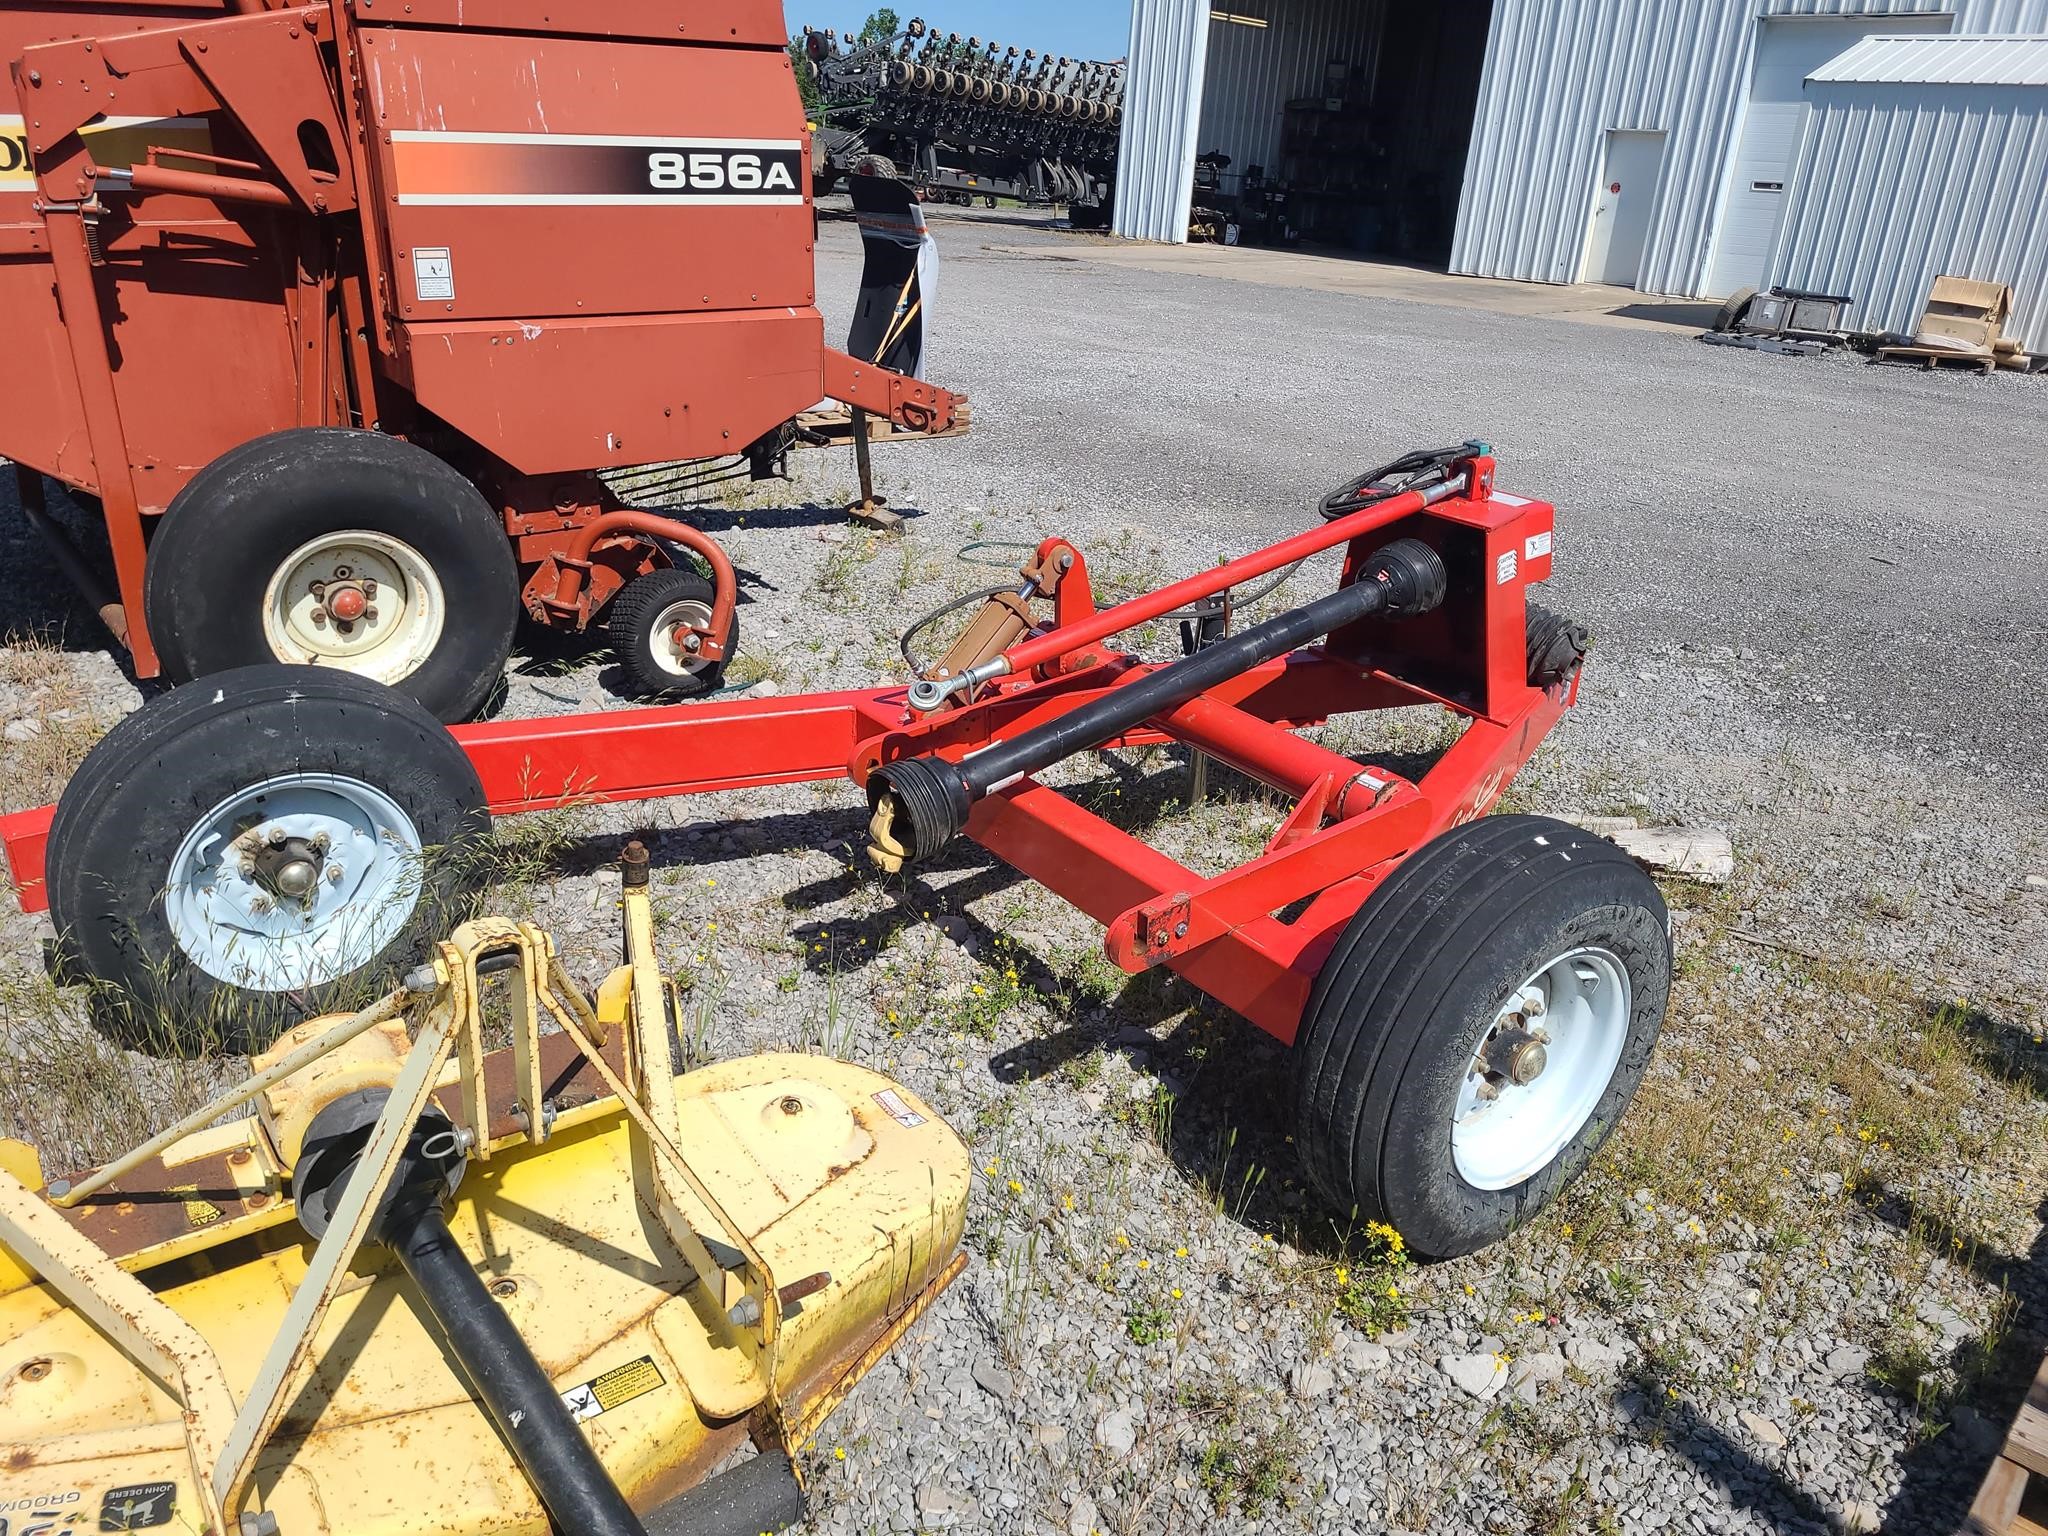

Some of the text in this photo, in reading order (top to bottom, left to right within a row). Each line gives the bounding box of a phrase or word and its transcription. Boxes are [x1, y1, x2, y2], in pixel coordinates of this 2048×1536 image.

[648, 152, 796, 190] 856A
[602, 1360, 642, 1381] WARNING
[108, 1484, 173, 1500] JOHN DEERE
